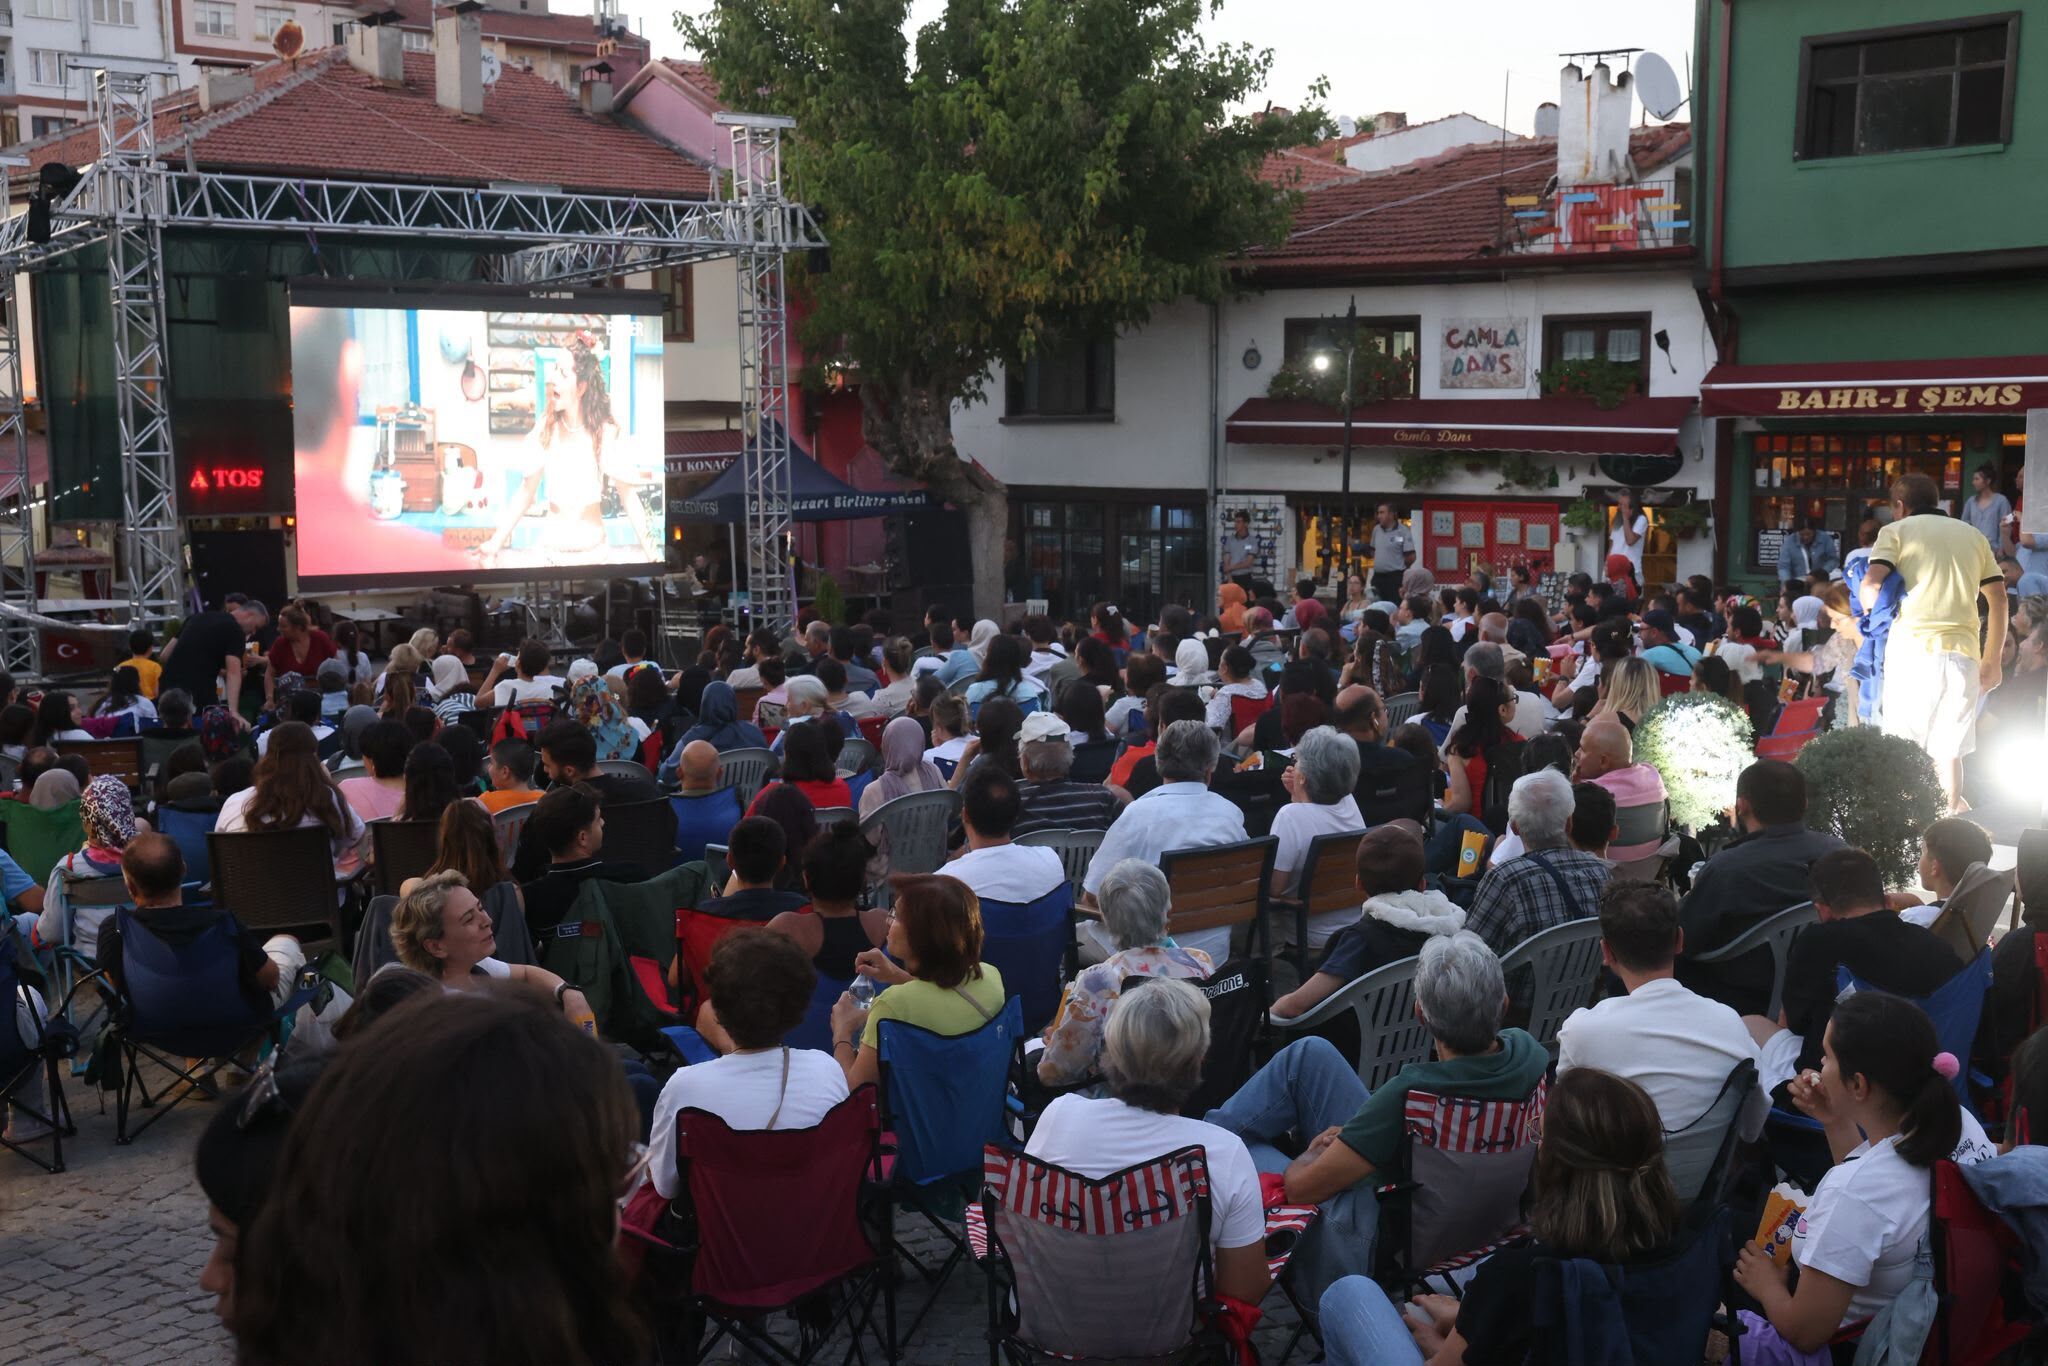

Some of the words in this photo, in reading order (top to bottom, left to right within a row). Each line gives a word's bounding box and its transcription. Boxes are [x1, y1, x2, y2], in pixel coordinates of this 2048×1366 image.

[1446, 327, 1519, 349] CAMLA
[1451, 353, 1512, 376] DANS
[1777, 388, 1909, 409] BAHR-I
[1918, 384, 2023, 413] ŞEMS
[1437, 429, 1472, 442] Dans
[664, 461, 682, 472] NLI
[687, 457, 735, 472] KONAĞ
[213, 469, 264, 488] TOS
